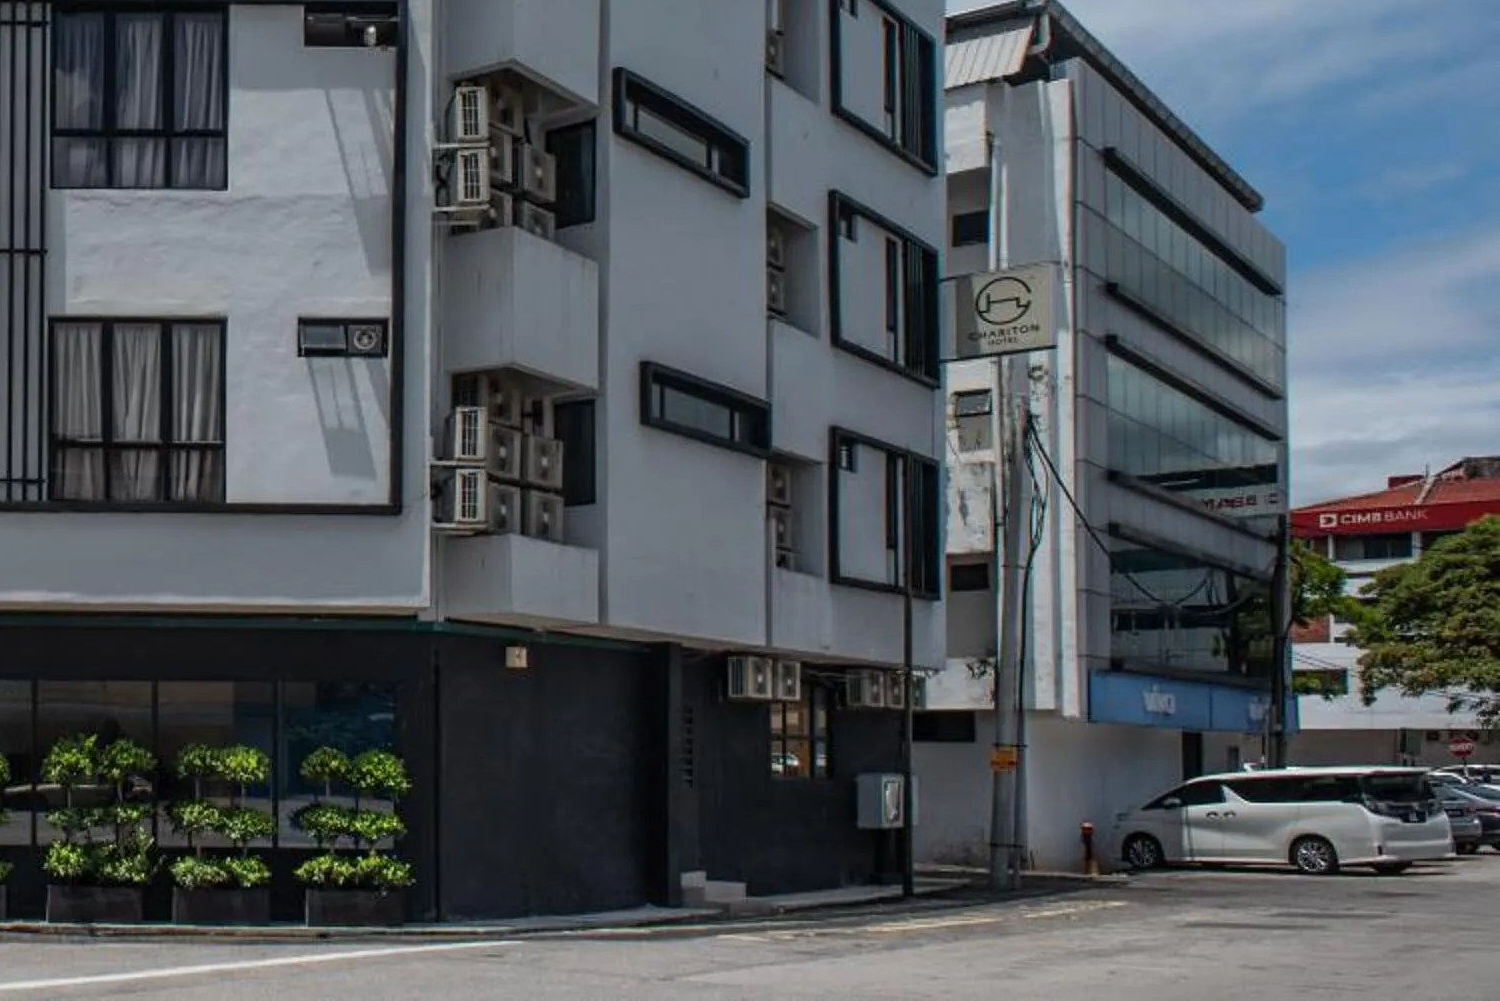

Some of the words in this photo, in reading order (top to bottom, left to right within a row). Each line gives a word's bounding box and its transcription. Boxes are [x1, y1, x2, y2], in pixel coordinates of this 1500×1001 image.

[968, 324, 1040, 342] CHARITON
[1340, 512, 1382, 524] CIMB
[1383, 509, 1428, 522] BANK
